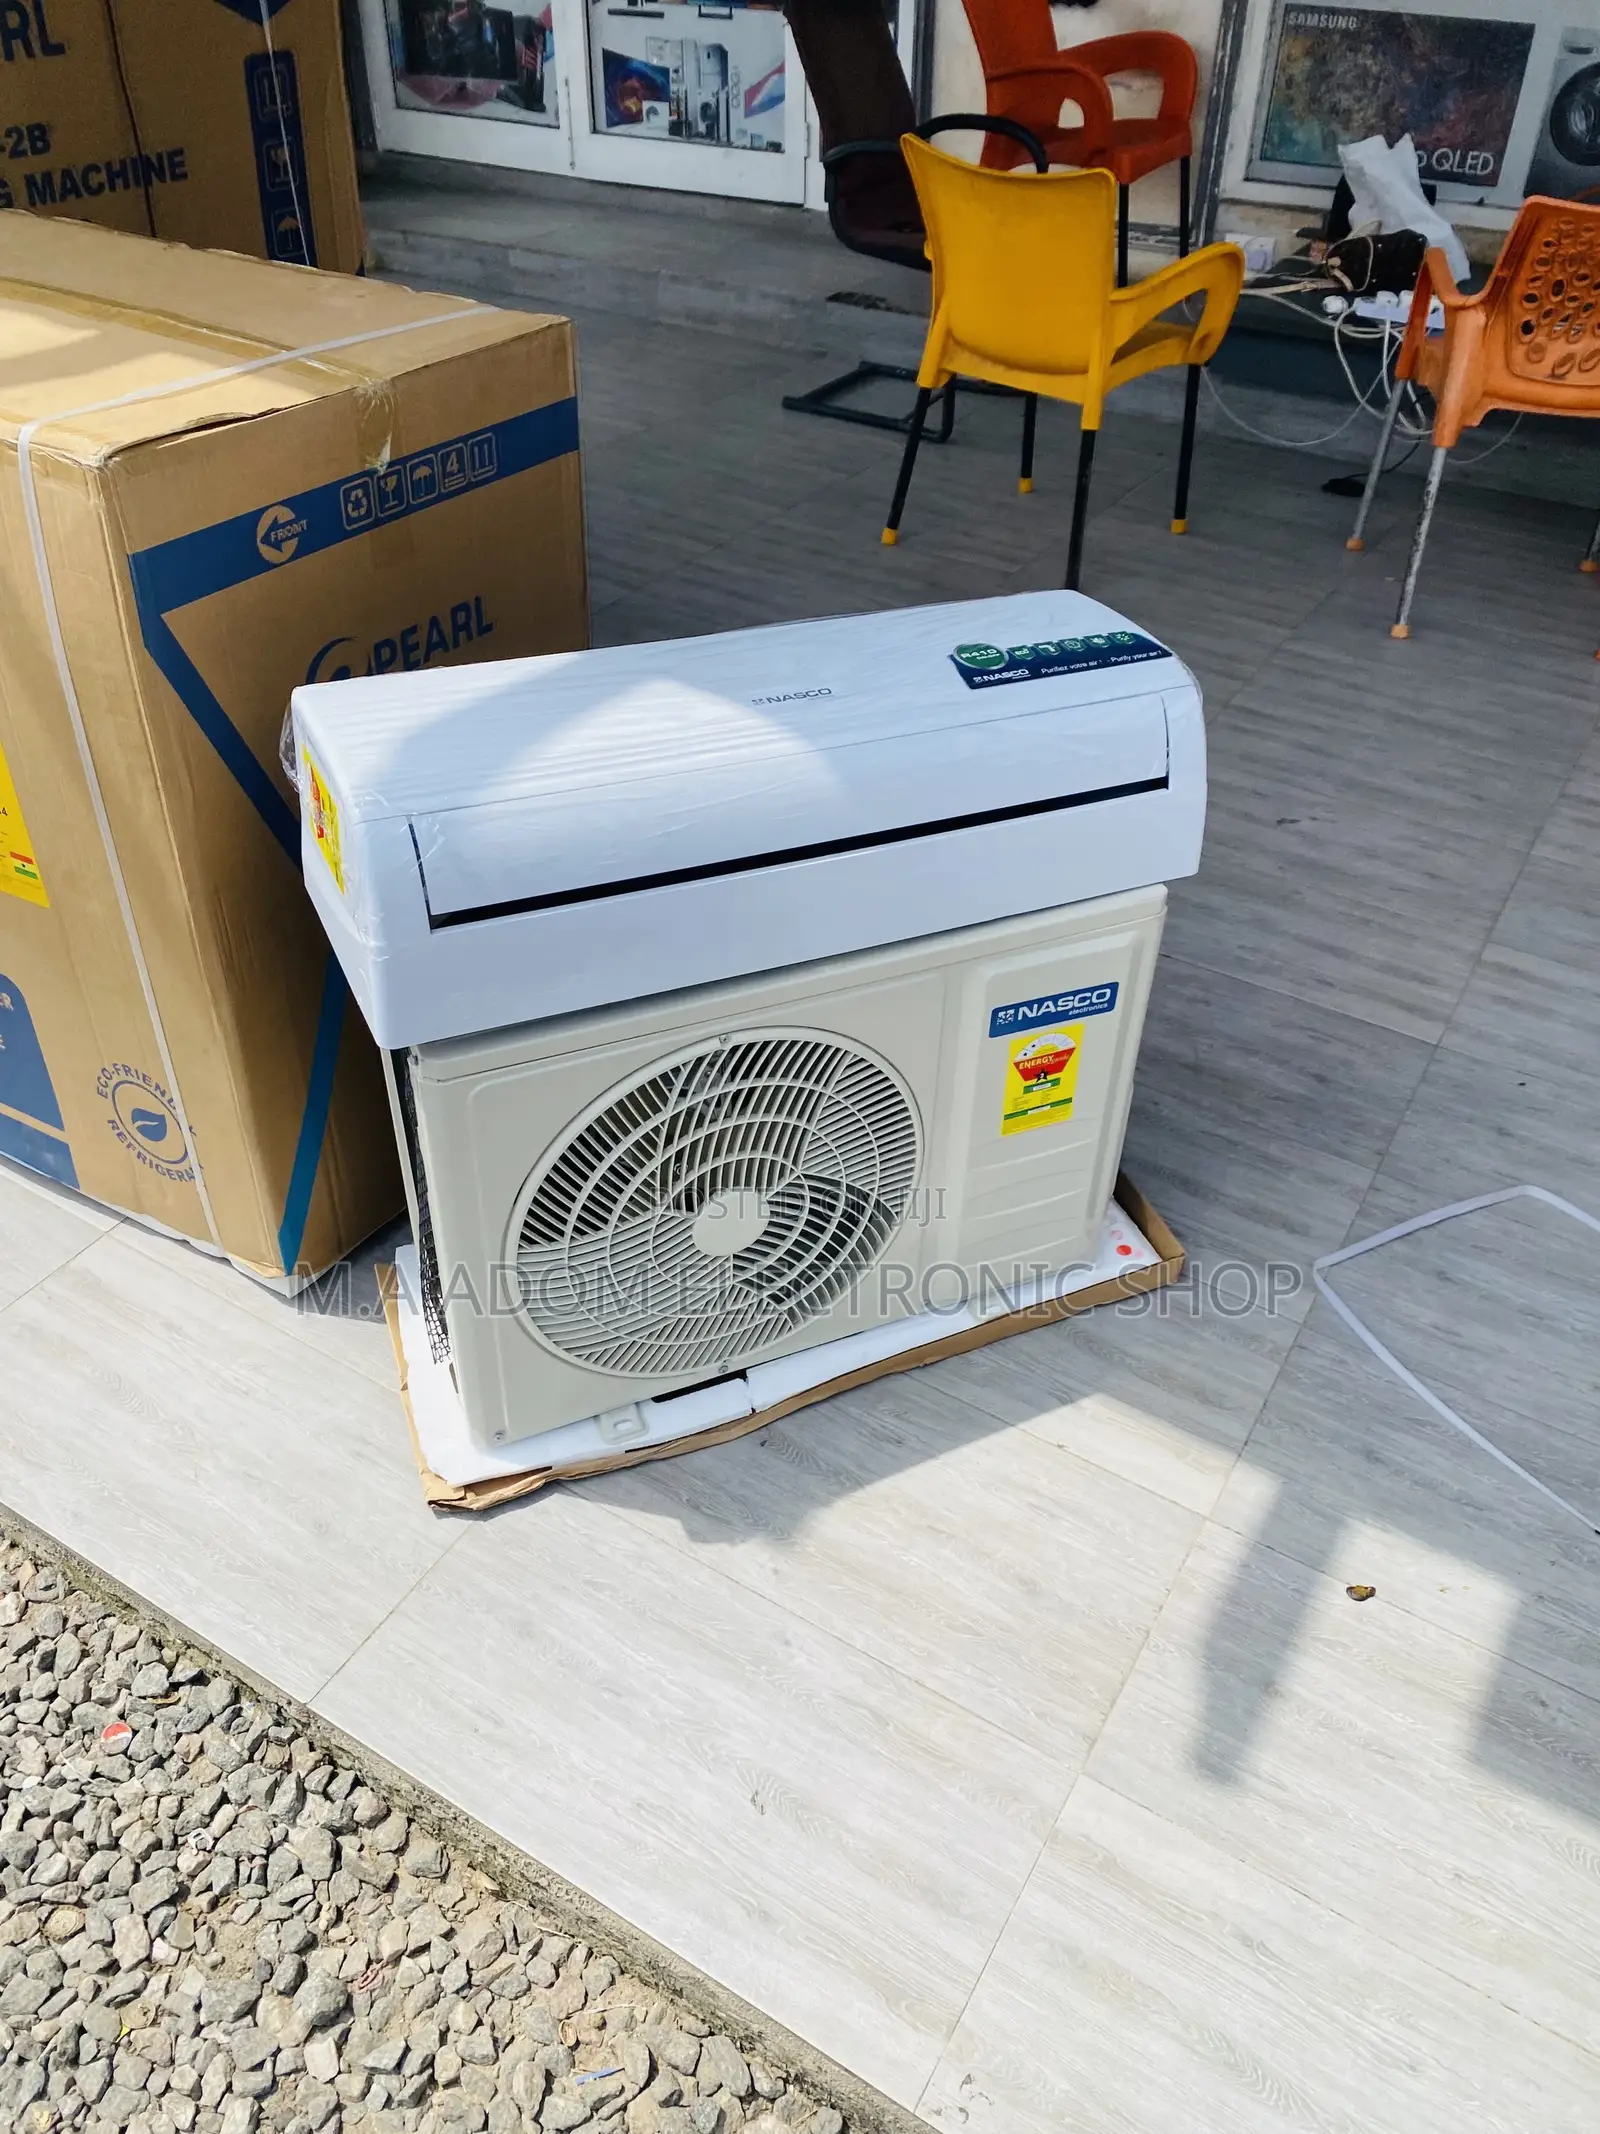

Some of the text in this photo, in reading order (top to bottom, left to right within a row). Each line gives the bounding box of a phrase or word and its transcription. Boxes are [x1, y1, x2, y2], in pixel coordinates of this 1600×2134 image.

[1288, 11, 1358, 31] SAMSUNG
[1432, 148, 1494, 176] QLED
[24, 147, 188, 207] MACHINE
[373, 596, 494, 676] PEARL
[1069, 662, 1088, 670] votre
[1132, 652, 1148, 660] your
[983, 669, 1029, 681] NASCO
[766, 687, 832, 704] NASCO
[1017, 988, 1111, 1021] NASCO
[1069, 1003, 1108, 1015] electronics
[1019, 1054, 1055, 1070] ENERGY
